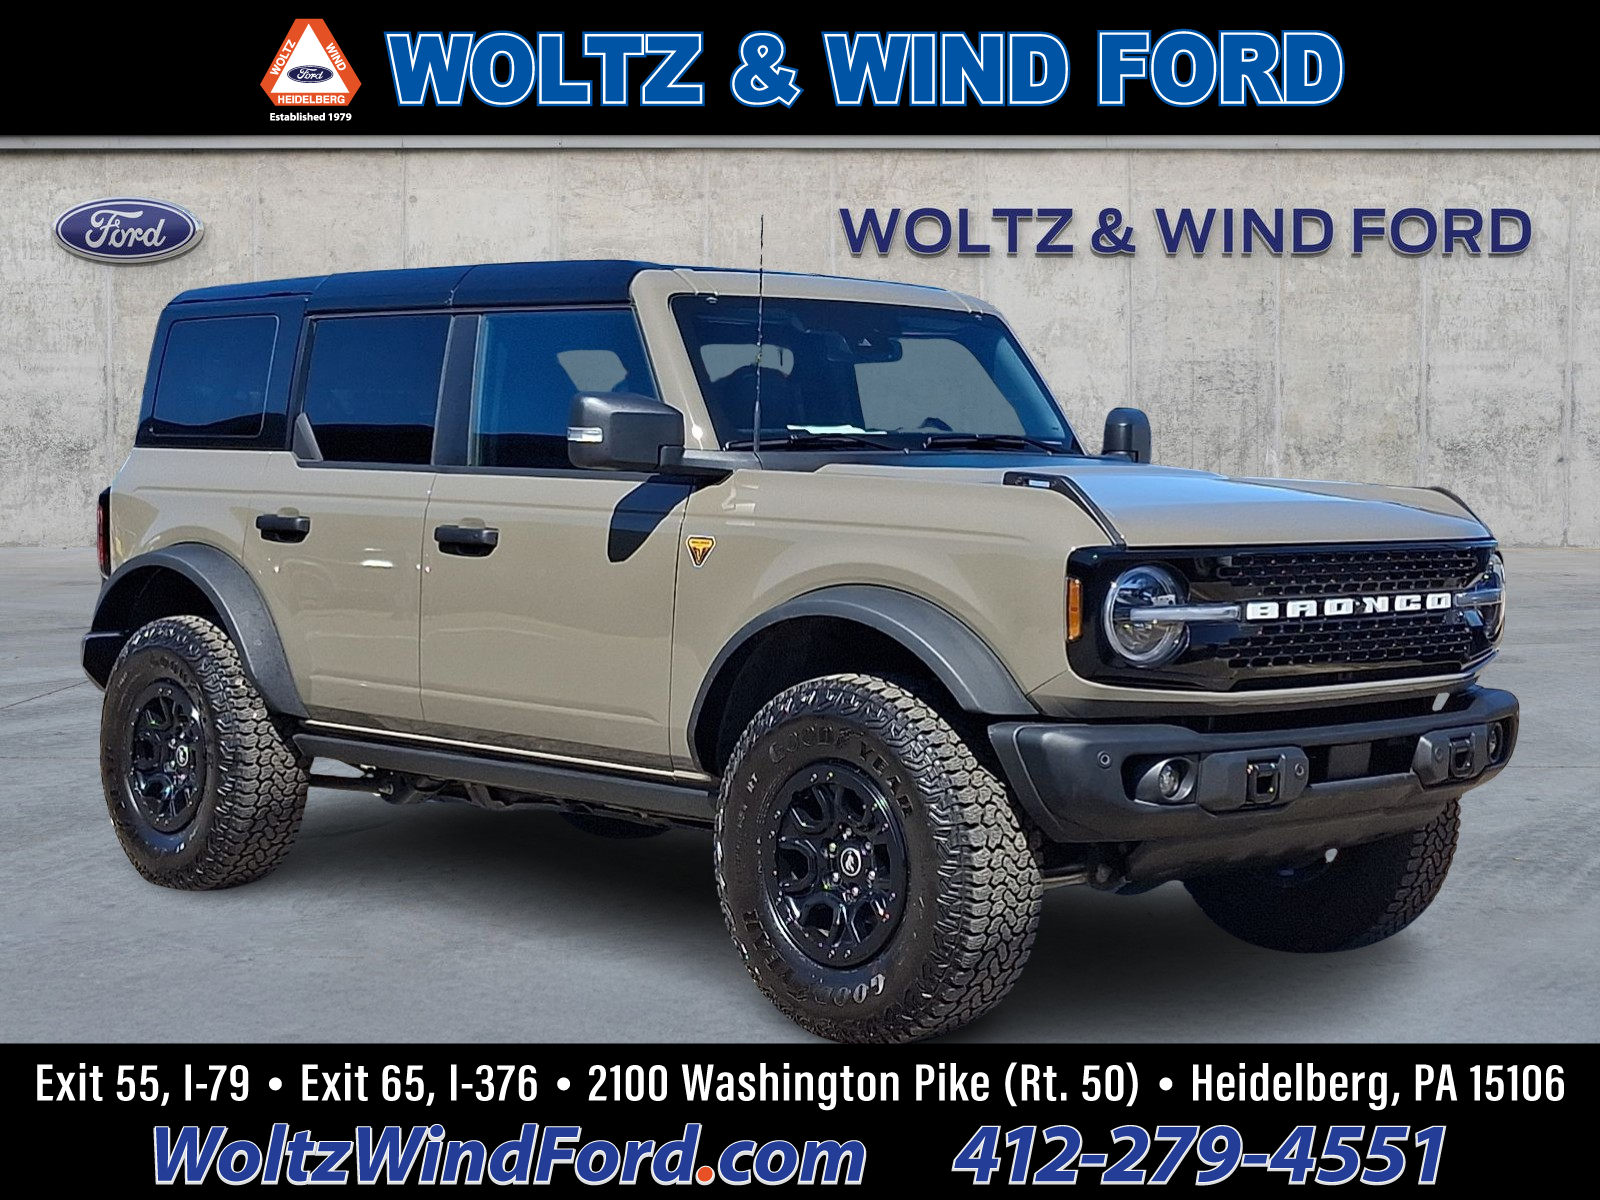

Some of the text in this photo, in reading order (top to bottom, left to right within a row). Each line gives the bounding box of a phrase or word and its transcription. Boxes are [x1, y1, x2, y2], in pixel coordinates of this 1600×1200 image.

[85, 209, 166, 249] Ford
[839, 207, 1532, 254] WOLTZ & WIND FORD
[1246, 593, 1452, 620] BRONCO
